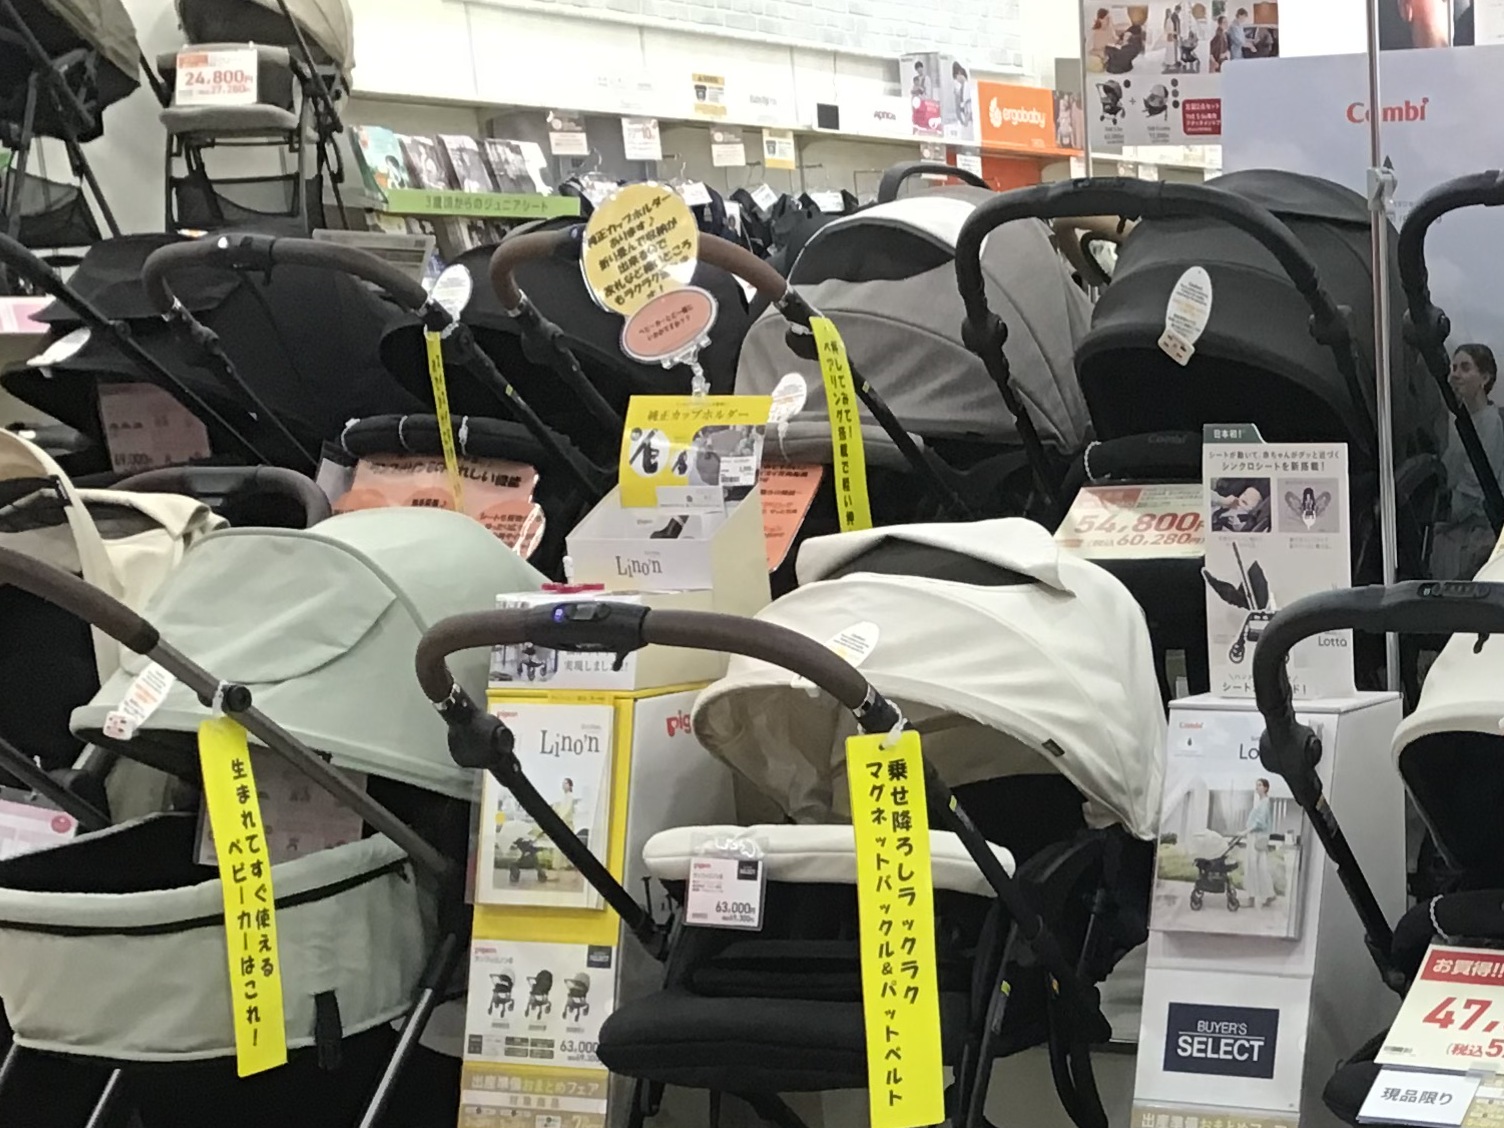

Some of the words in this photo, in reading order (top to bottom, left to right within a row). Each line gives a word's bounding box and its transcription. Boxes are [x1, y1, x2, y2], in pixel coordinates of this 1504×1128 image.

[1002, 107, 1046, 129] ergobaby
[1346, 97, 1429, 123] Cmbi
[1318, 636, 1348, 648] Lotta
[564, 659, 629, 672] 実現しまし!
[666, 709, 693, 737] pig
[540, 729, 600, 757] Lino'n
[231, 758, 275, 978] 生まれてすぐ使える
[887, 759, 919, 1005] 乗せ降ろしラックラク
[228, 838, 261, 1047] ベビーカーはこれ!
[1197, 1020, 1248, 1036] BUYER'S
[1177, 1035, 1265, 1062] SELECT
[1380, 1087, 1454, 1106] 現品限り
